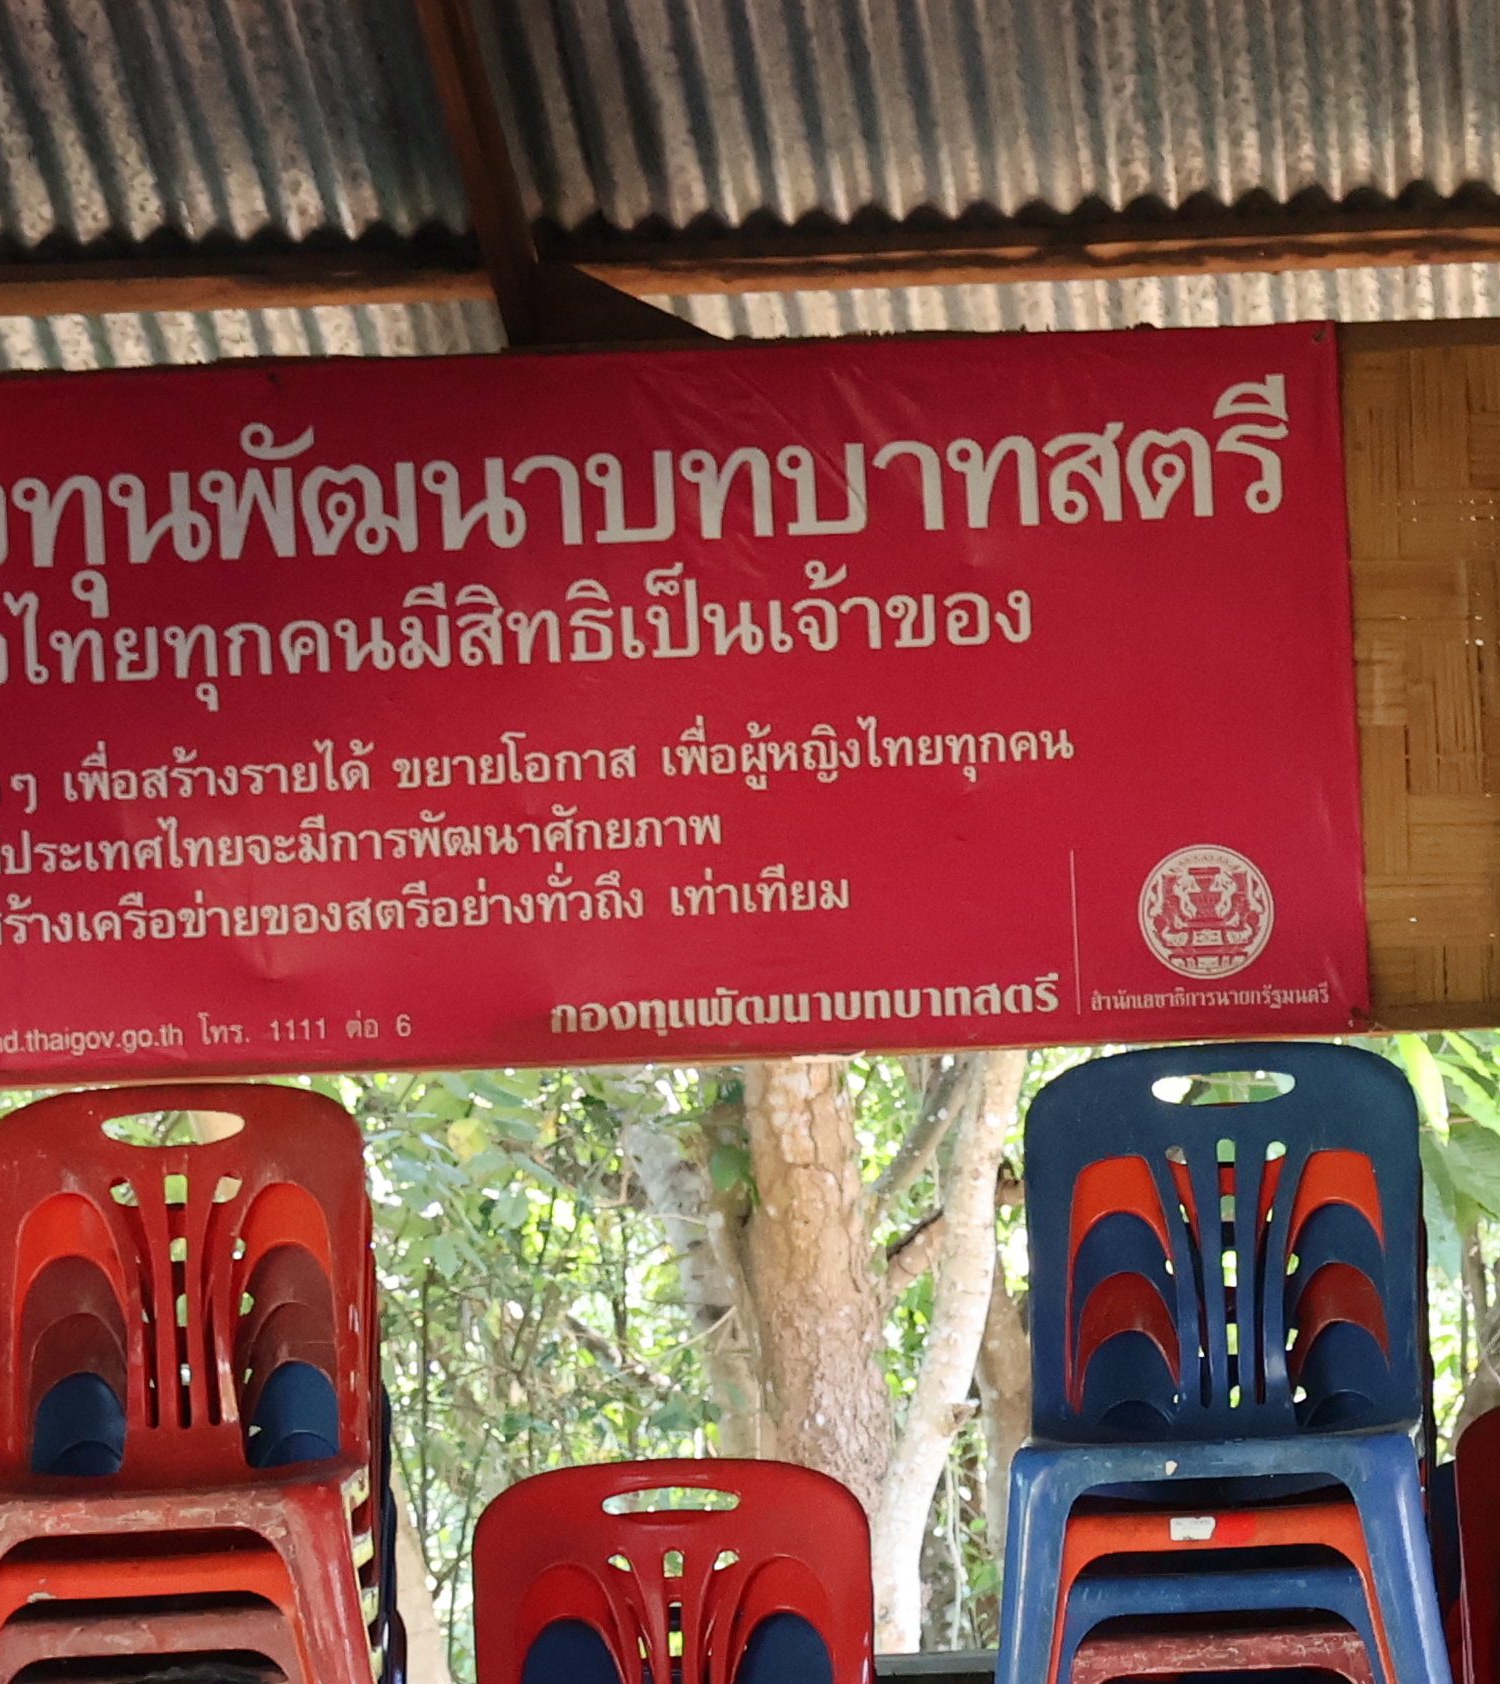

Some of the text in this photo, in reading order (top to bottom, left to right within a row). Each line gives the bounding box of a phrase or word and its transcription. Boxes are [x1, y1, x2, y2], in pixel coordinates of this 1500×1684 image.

[62, 739, 374, 801] เพื่อสร้างรายได้
[392, 733, 637, 789] ขยายโอกาส
[661, 715, 1075, 789] เพื่อผู้หญิงไทยทุกคน
[670, 864, 850, 917] เท่าเทียม
[197, 1011, 251, 1045] โทร.
[270, 1018, 328, 1042] 1111
[345, 1010, 379, 1039] ต่อ
[396, 1014, 412, 1038] 6
[550, 972, 1060, 1037] กองทุนพัฒนาบทบาทสตรี
